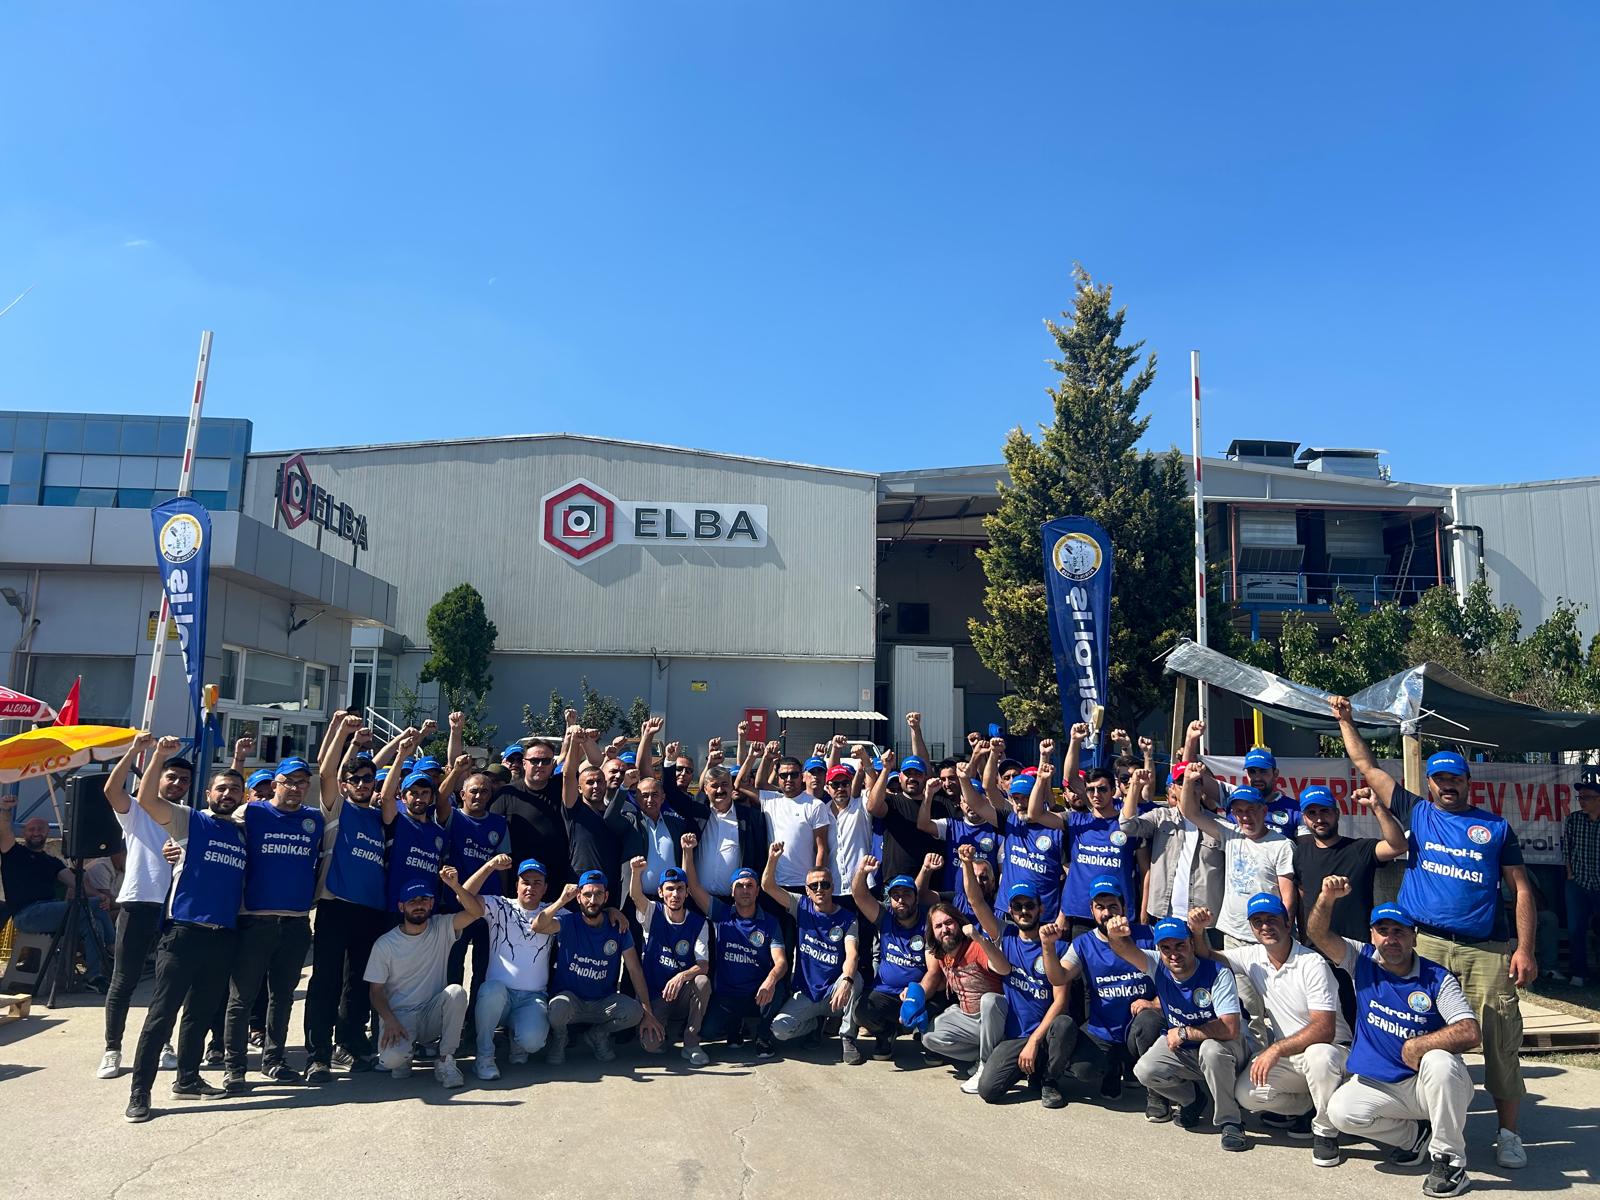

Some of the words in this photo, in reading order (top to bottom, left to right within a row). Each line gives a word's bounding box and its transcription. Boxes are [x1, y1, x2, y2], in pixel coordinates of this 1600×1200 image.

[310, 483, 368, 551] ELBA
[634, 507, 759, 541] ELBA
[2, 704, 32, 713] ALGIDA
[1514, 782, 1572, 823] VAR
[203, 850, 247, 870] SENDİKAS
[1077, 854, 1121, 868] SENDİKASI
[1425, 841, 1483, 861] petrol-iş
[1422, 860, 1483, 883] SENDİKASI
[1095, 971, 1145, 984] petrol-iş
[1097, 984, 1147, 998] SENDİKASI
[1369, 999, 1428, 1024] petrol-iş
[1367, 1012, 1428, 1040] SENDİKA
